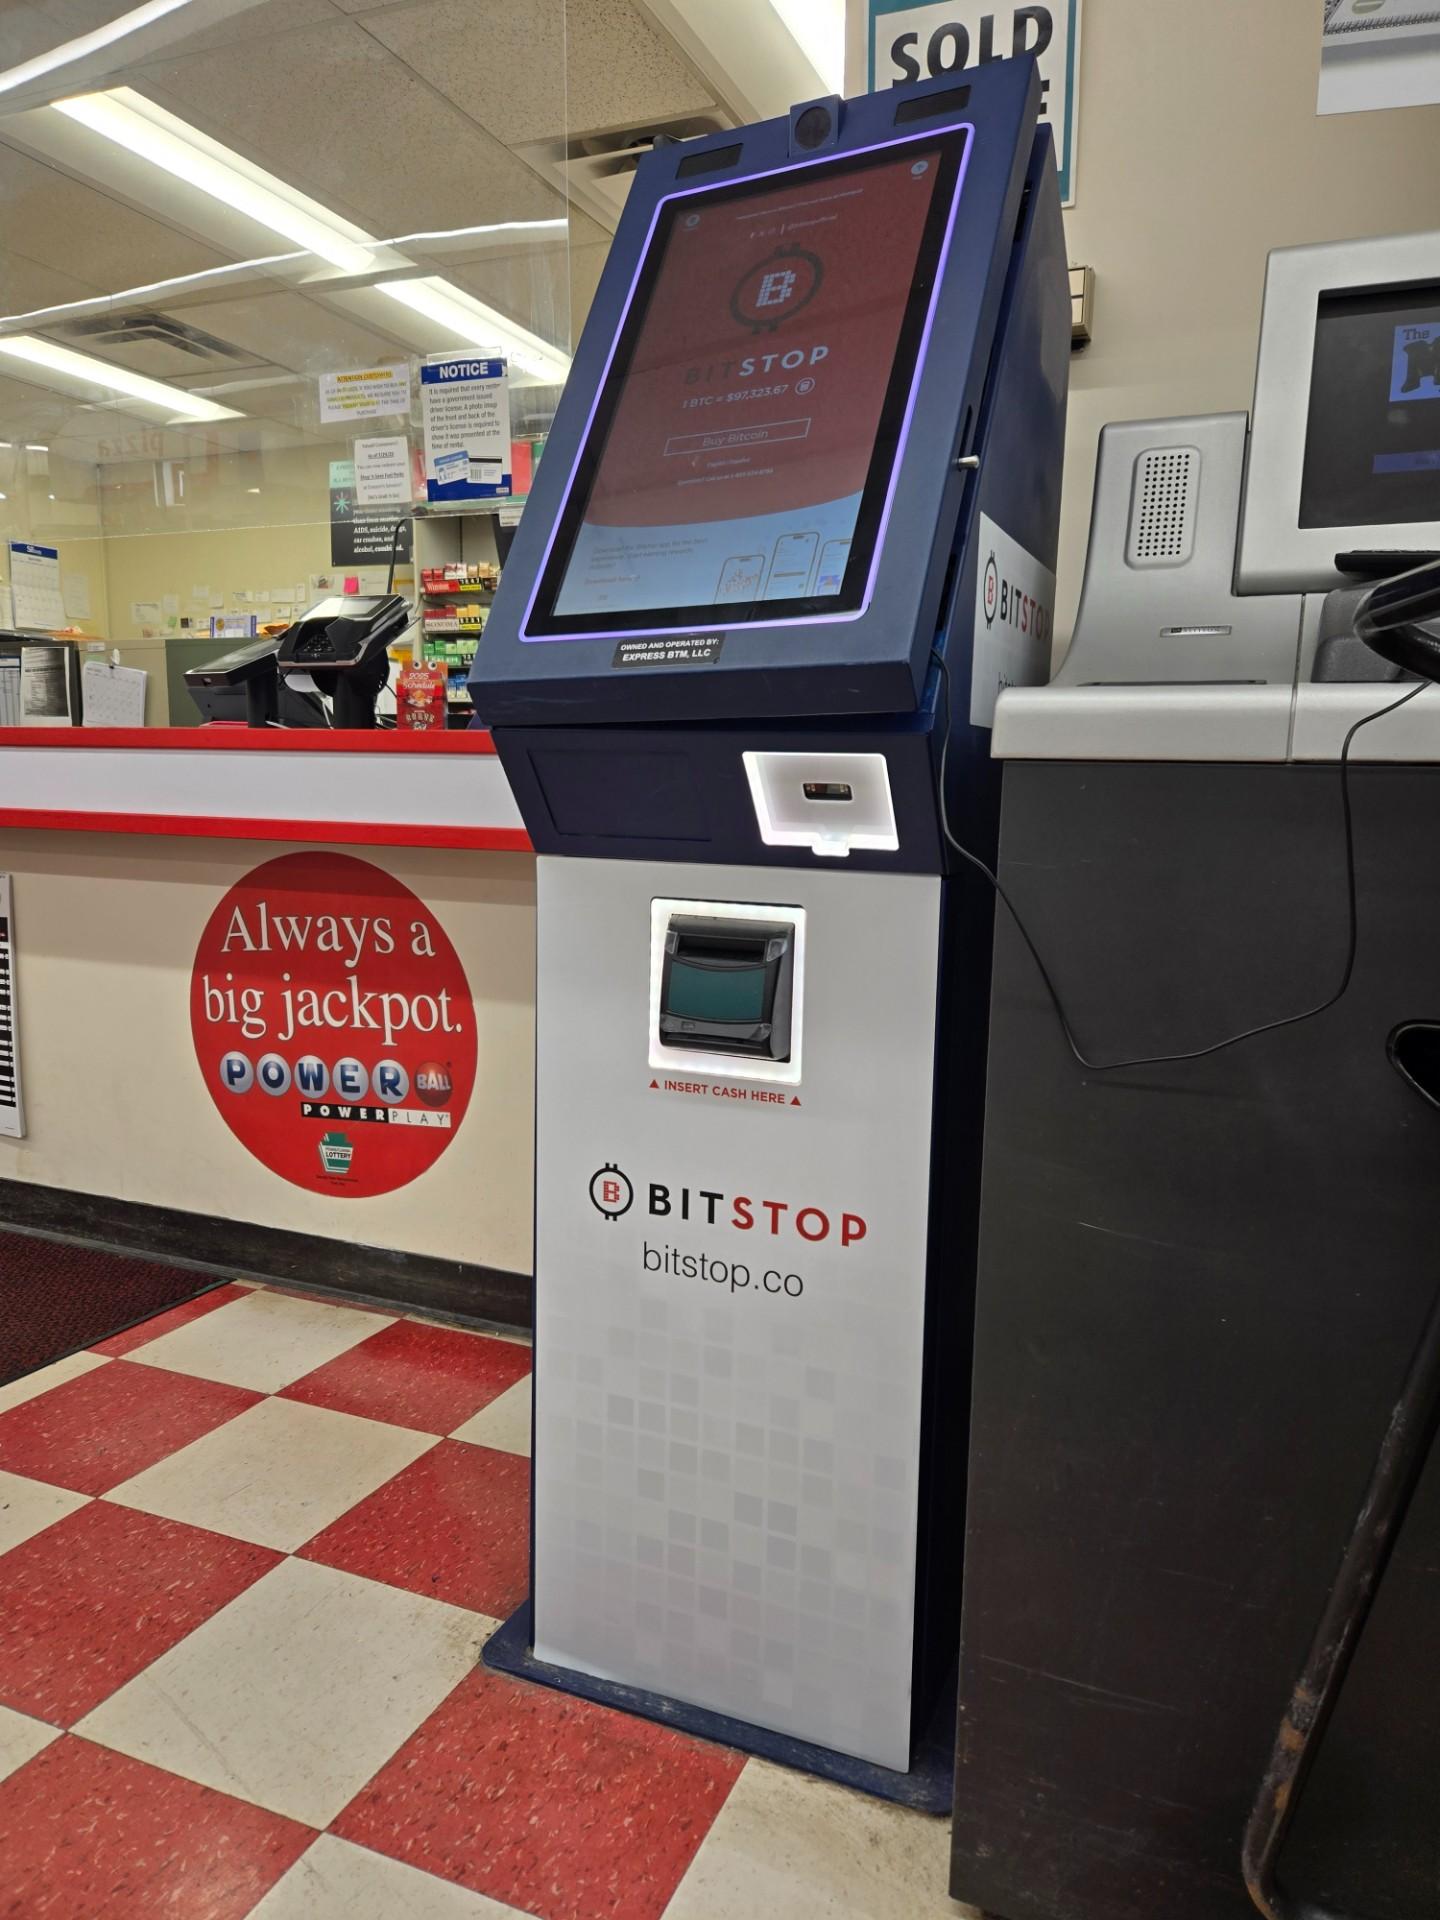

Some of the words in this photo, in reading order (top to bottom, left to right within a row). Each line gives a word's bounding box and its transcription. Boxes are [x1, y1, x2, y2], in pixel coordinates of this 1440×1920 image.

[890, 5, 1053, 82] SOLD
[1403, 327, 1430, 341] The
[439, 362, 488, 379] NOTICE
[685, 345, 829, 386] BITSTOP
[689, 394, 713, 408] BTC
[702, 434, 725, 449] Buy
[727, 428, 769, 445] Bitcoin
[353, 526, 369, 534] AIDS,
[390, 525, 407, 533] drgs,
[620, 642, 648, 651] OWNED
[648, 641, 664, 649] AND
[665, 639, 705, 649] OPERATED
[706, 638, 719, 646] BY:
[622, 651, 665, 662] EXPRESS
[667, 649, 690, 660] BTM,
[692, 648, 711, 657] LLC
[221, 901, 396, 968] Always
[410, 920, 437, 957] a
[202, 972, 267, 1039] big
[277, 972, 463, 1046] jackpot.
[225, 1058, 404, 1097] POWER
[416, 1073, 452, 1091] BALL
[664, 1080, 709, 1095] INSERT
[712, 1086, 747, 1100] CASH
[751, 1091, 786, 1105] HERE
[304, 1103, 386, 1121] POWER
[391, 1110, 447, 1125] PLAY
[648, 1182, 868, 1248] BITSTOP
[643, 1241, 804, 1297] bitstop.co
